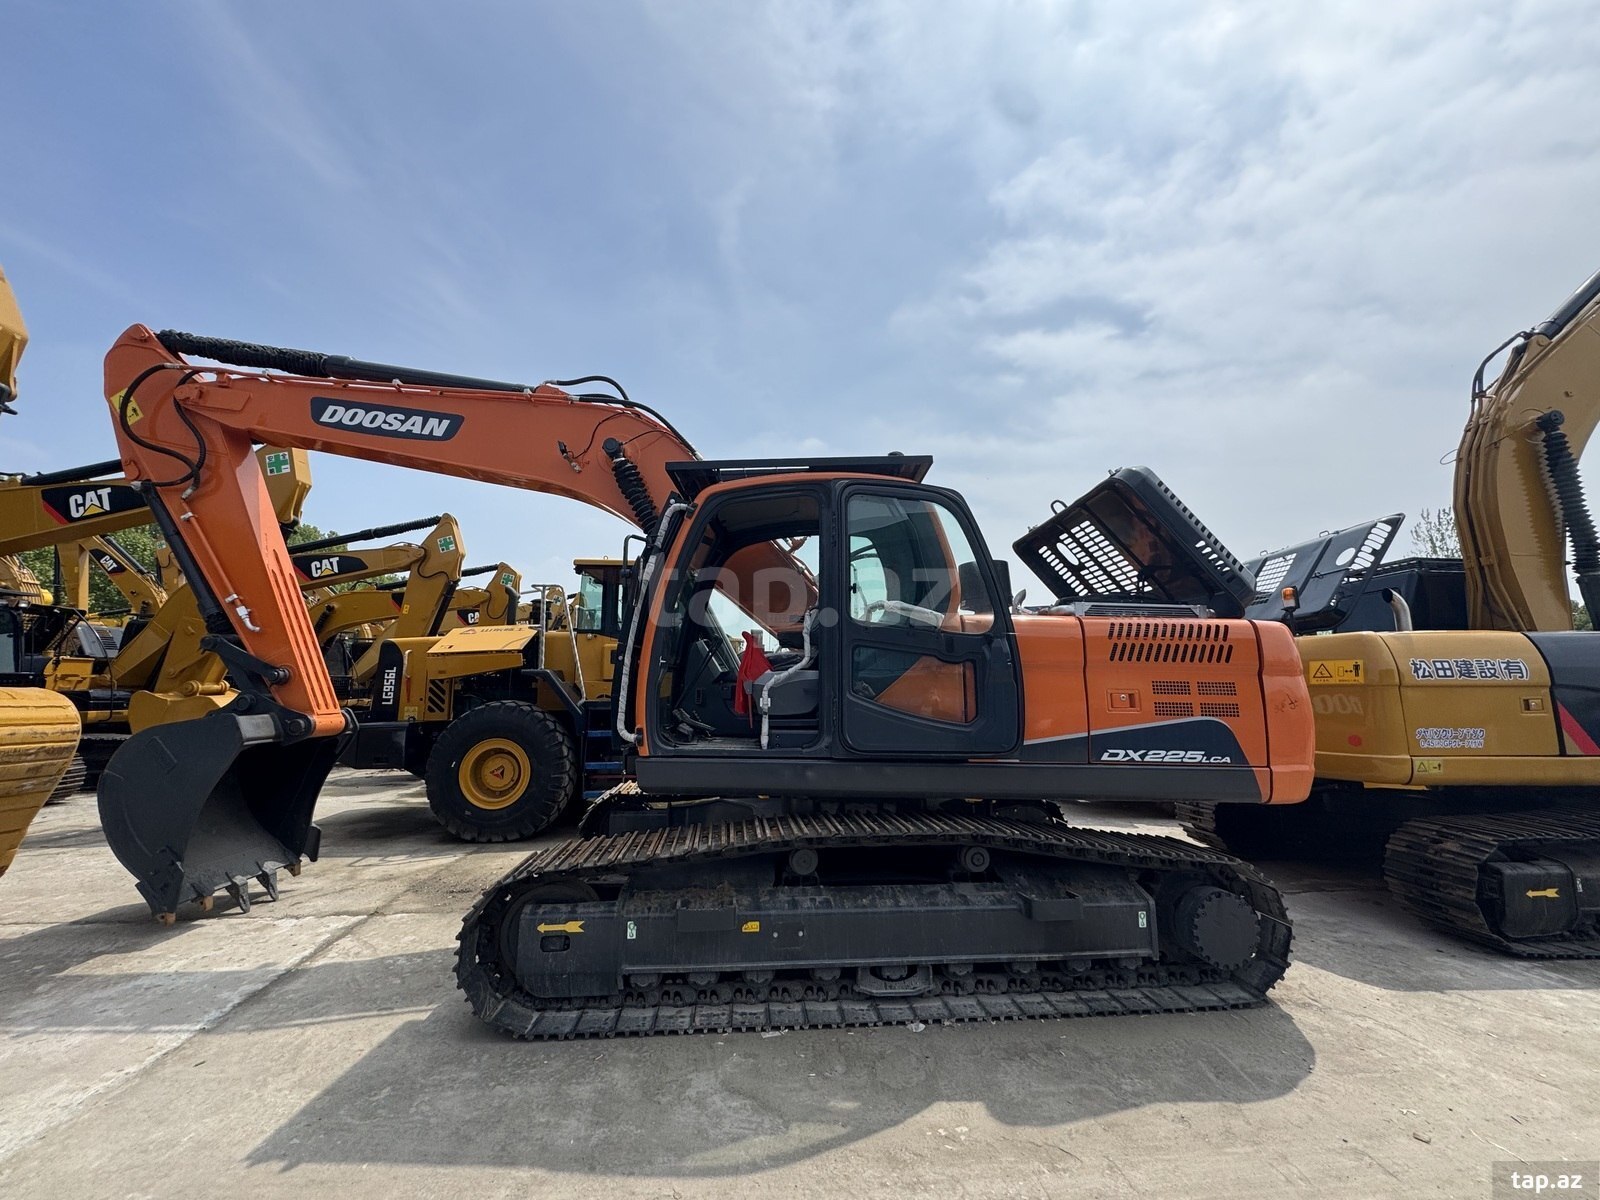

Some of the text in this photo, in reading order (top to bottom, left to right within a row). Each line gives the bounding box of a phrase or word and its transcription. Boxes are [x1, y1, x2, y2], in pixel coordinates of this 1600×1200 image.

[319, 404, 451, 437] DOOSAN
[69, 487, 112, 518] CAT
[100, 554, 118, 572] CAT
[310, 556, 340, 578] CAT
[1409, 657, 1529, 680] 松田建設(有)
[381, 666, 397, 705] LG956L
